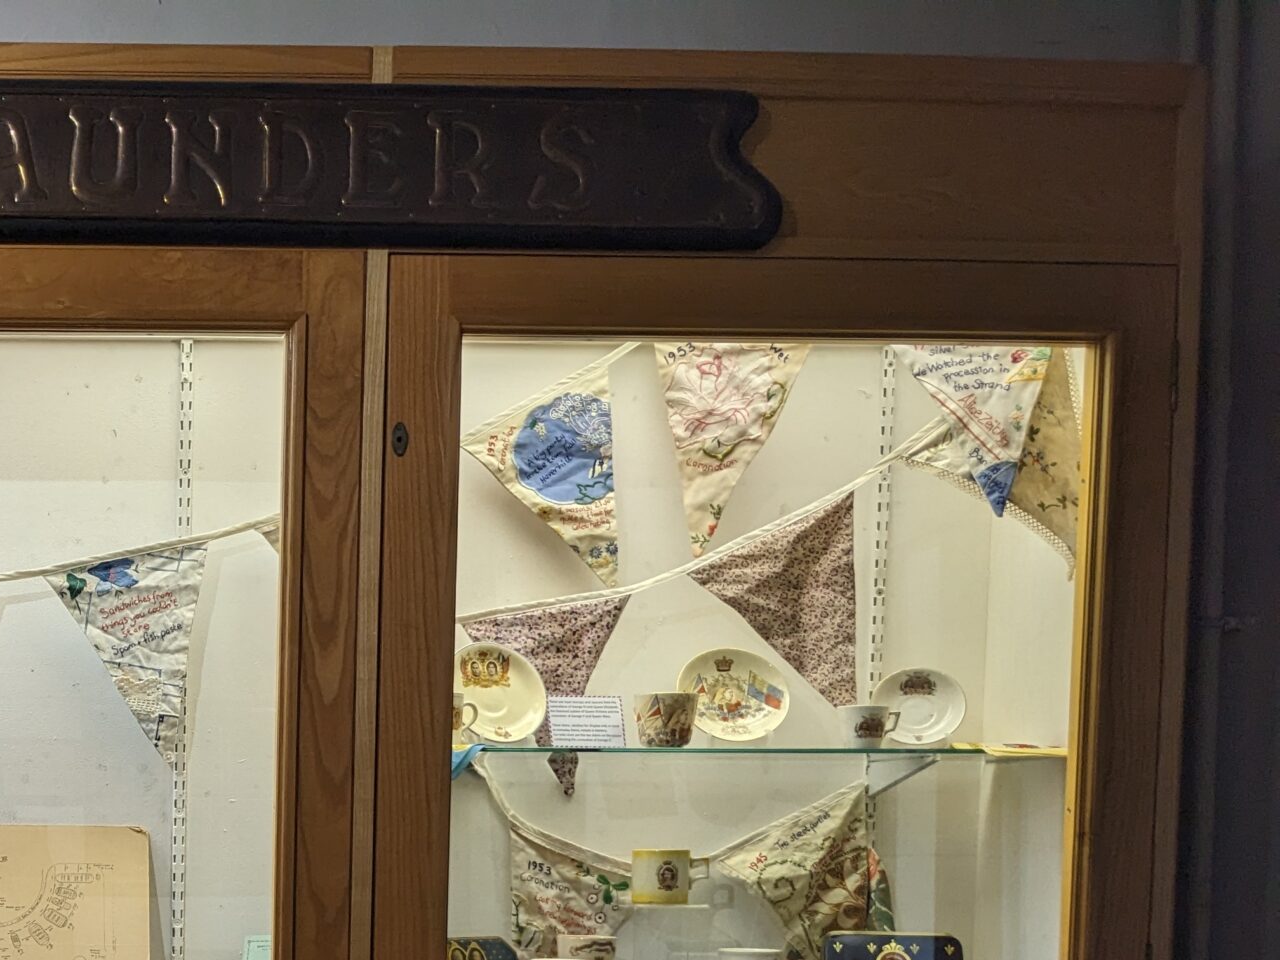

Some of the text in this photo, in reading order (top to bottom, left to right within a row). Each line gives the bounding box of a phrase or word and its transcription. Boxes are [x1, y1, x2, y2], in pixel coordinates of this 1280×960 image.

[663, 342, 696, 366] 1953
[978, 352, 1000, 363] the
[1000, 363, 1010, 374] in
[953, 378, 1011, 392] the Strand
[486, 435, 499, 457] 1953
[685, 458, 739, 473] Coronation
[99, 590, 173, 619] Sandwiches from
[101, 616, 129, 633] things
[130, 612, 146, 627] you
[111, 623, 183, 658] Spam fish paste
[527, 860, 552, 876] 1953
[748, 852, 768, 873] 1945
[520, 871, 570, 893] Coronation
